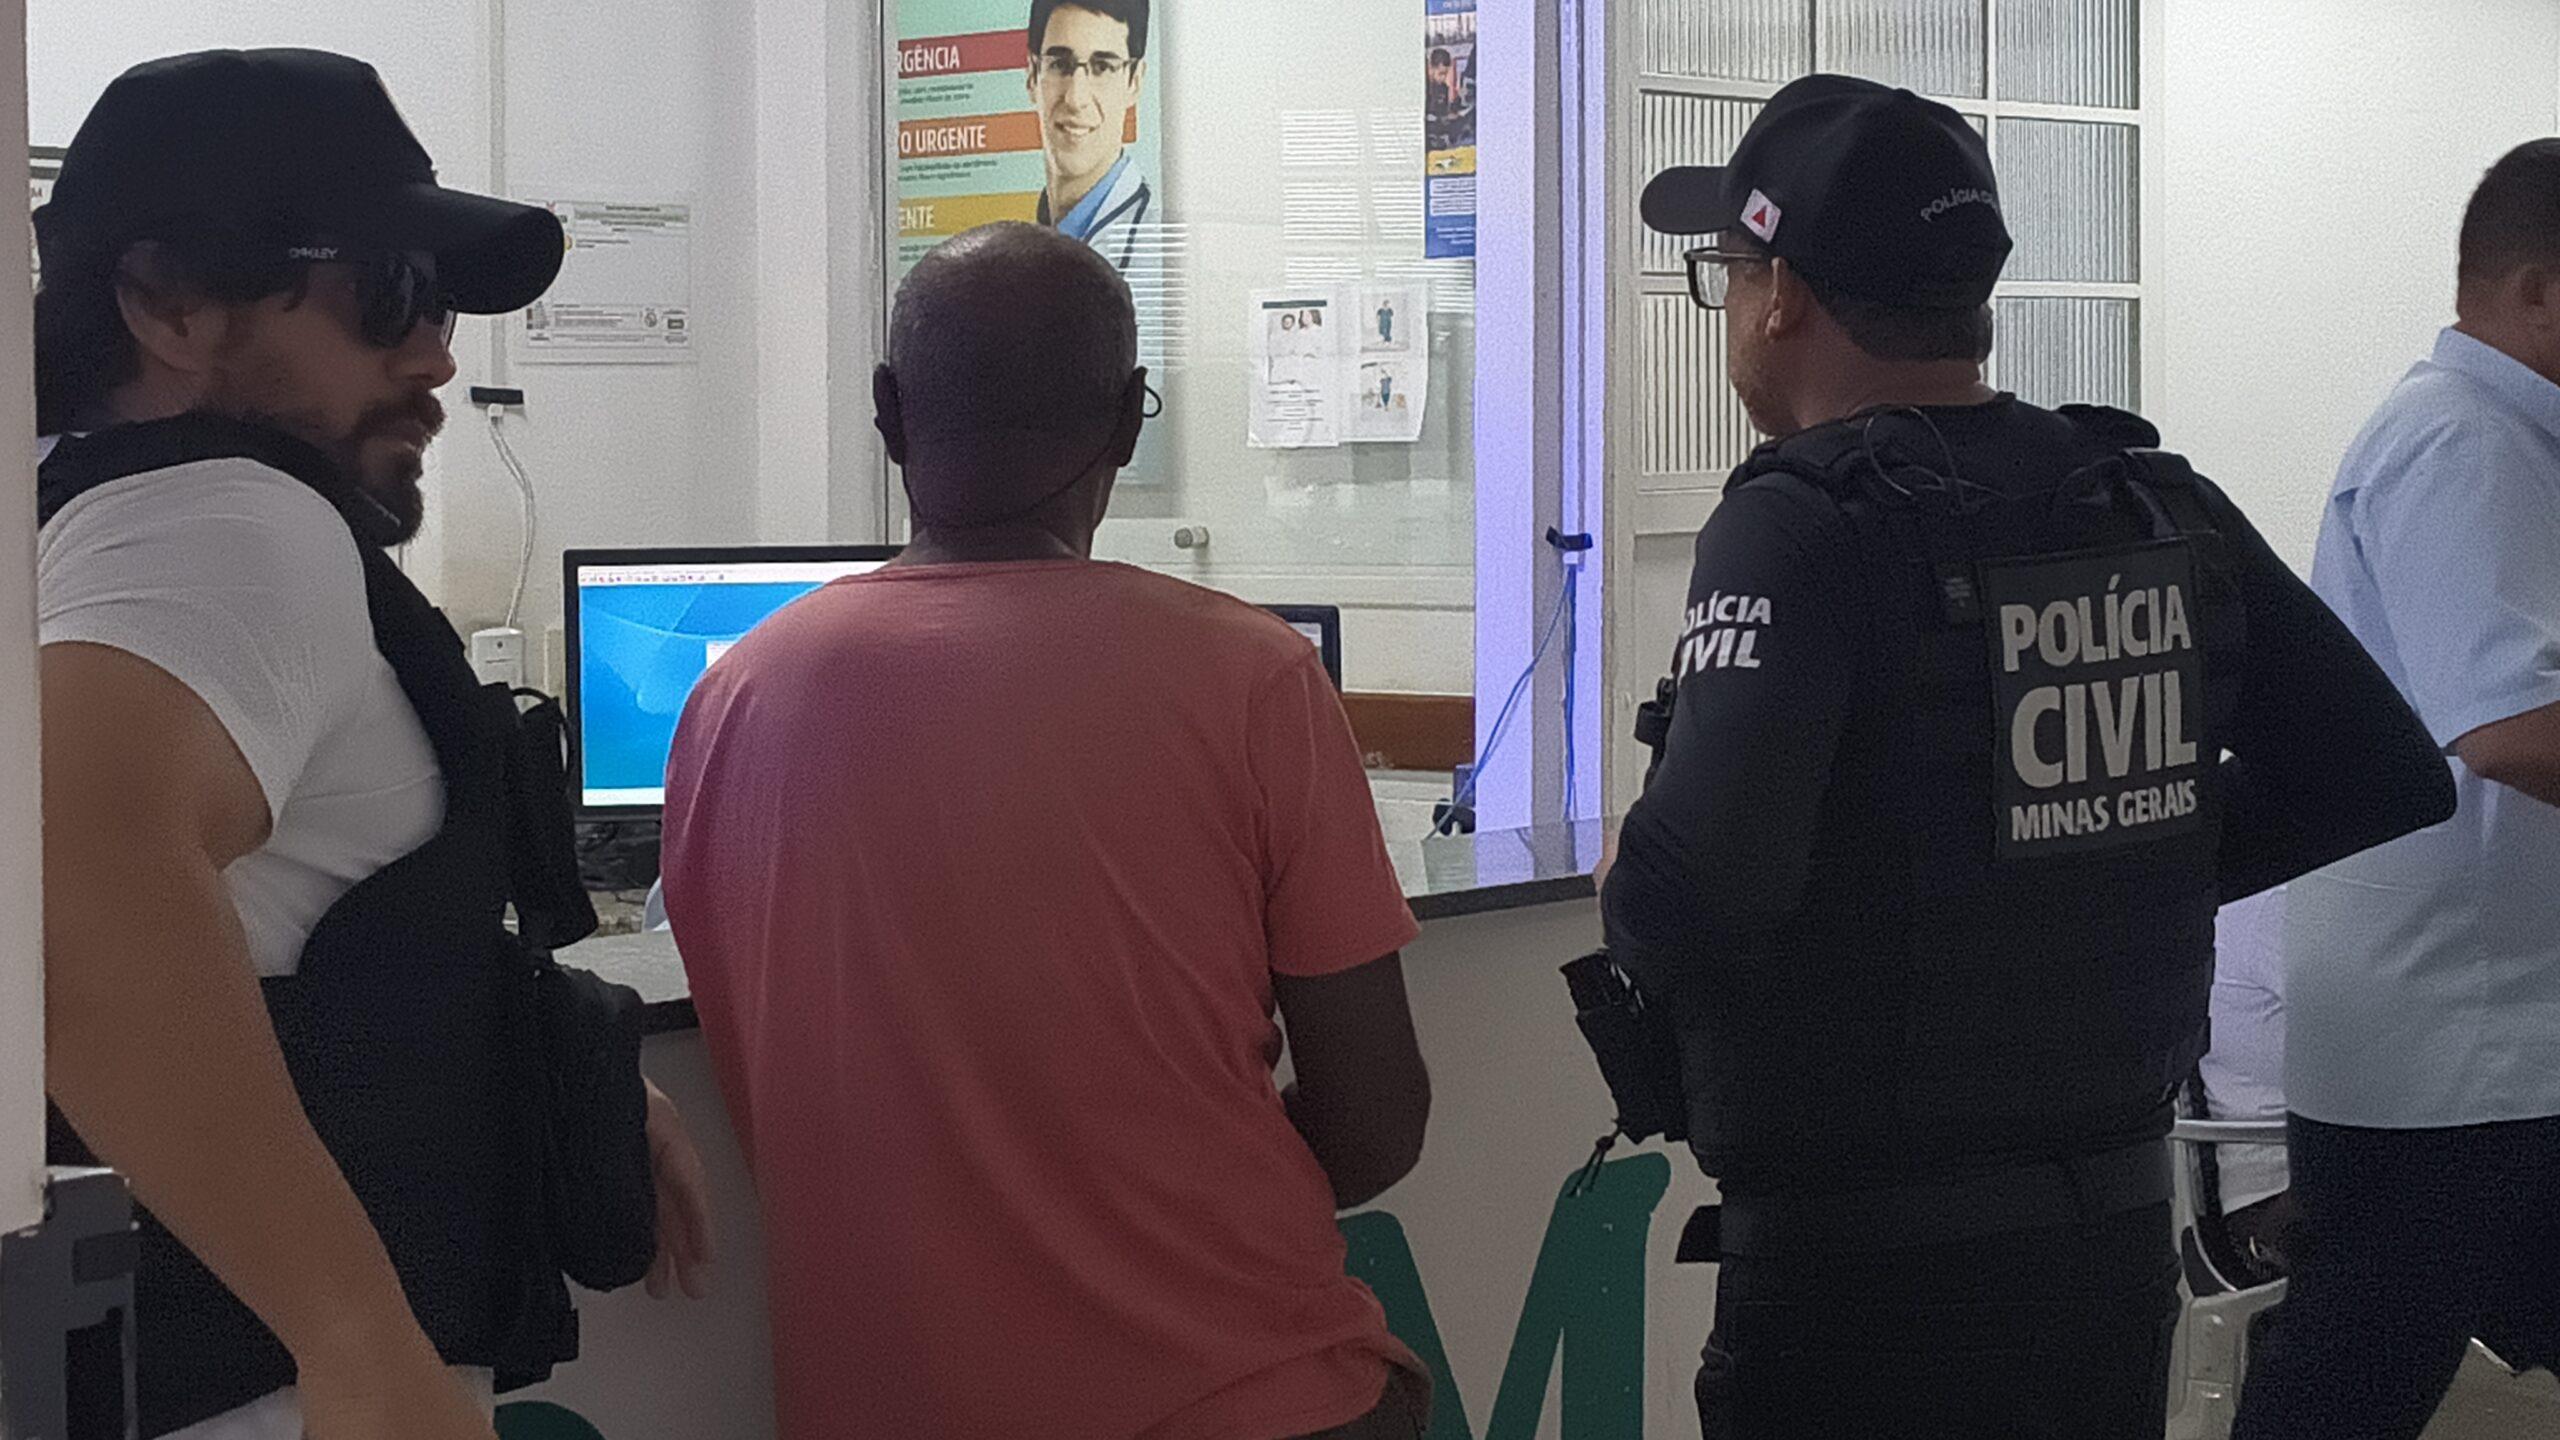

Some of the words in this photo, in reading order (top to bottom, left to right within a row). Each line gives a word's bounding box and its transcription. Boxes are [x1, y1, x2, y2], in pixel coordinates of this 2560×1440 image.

[915, 125, 987, 151] URGENTE
[1920, 187, 1980, 222] POLÍCIA
[2000, 573, 2192, 672] POLÍCIA
[2011, 670, 2197, 788] CIVIL
[2011, 795, 2110, 841] MINAS
[2116, 779, 2197, 827] GERAIS
